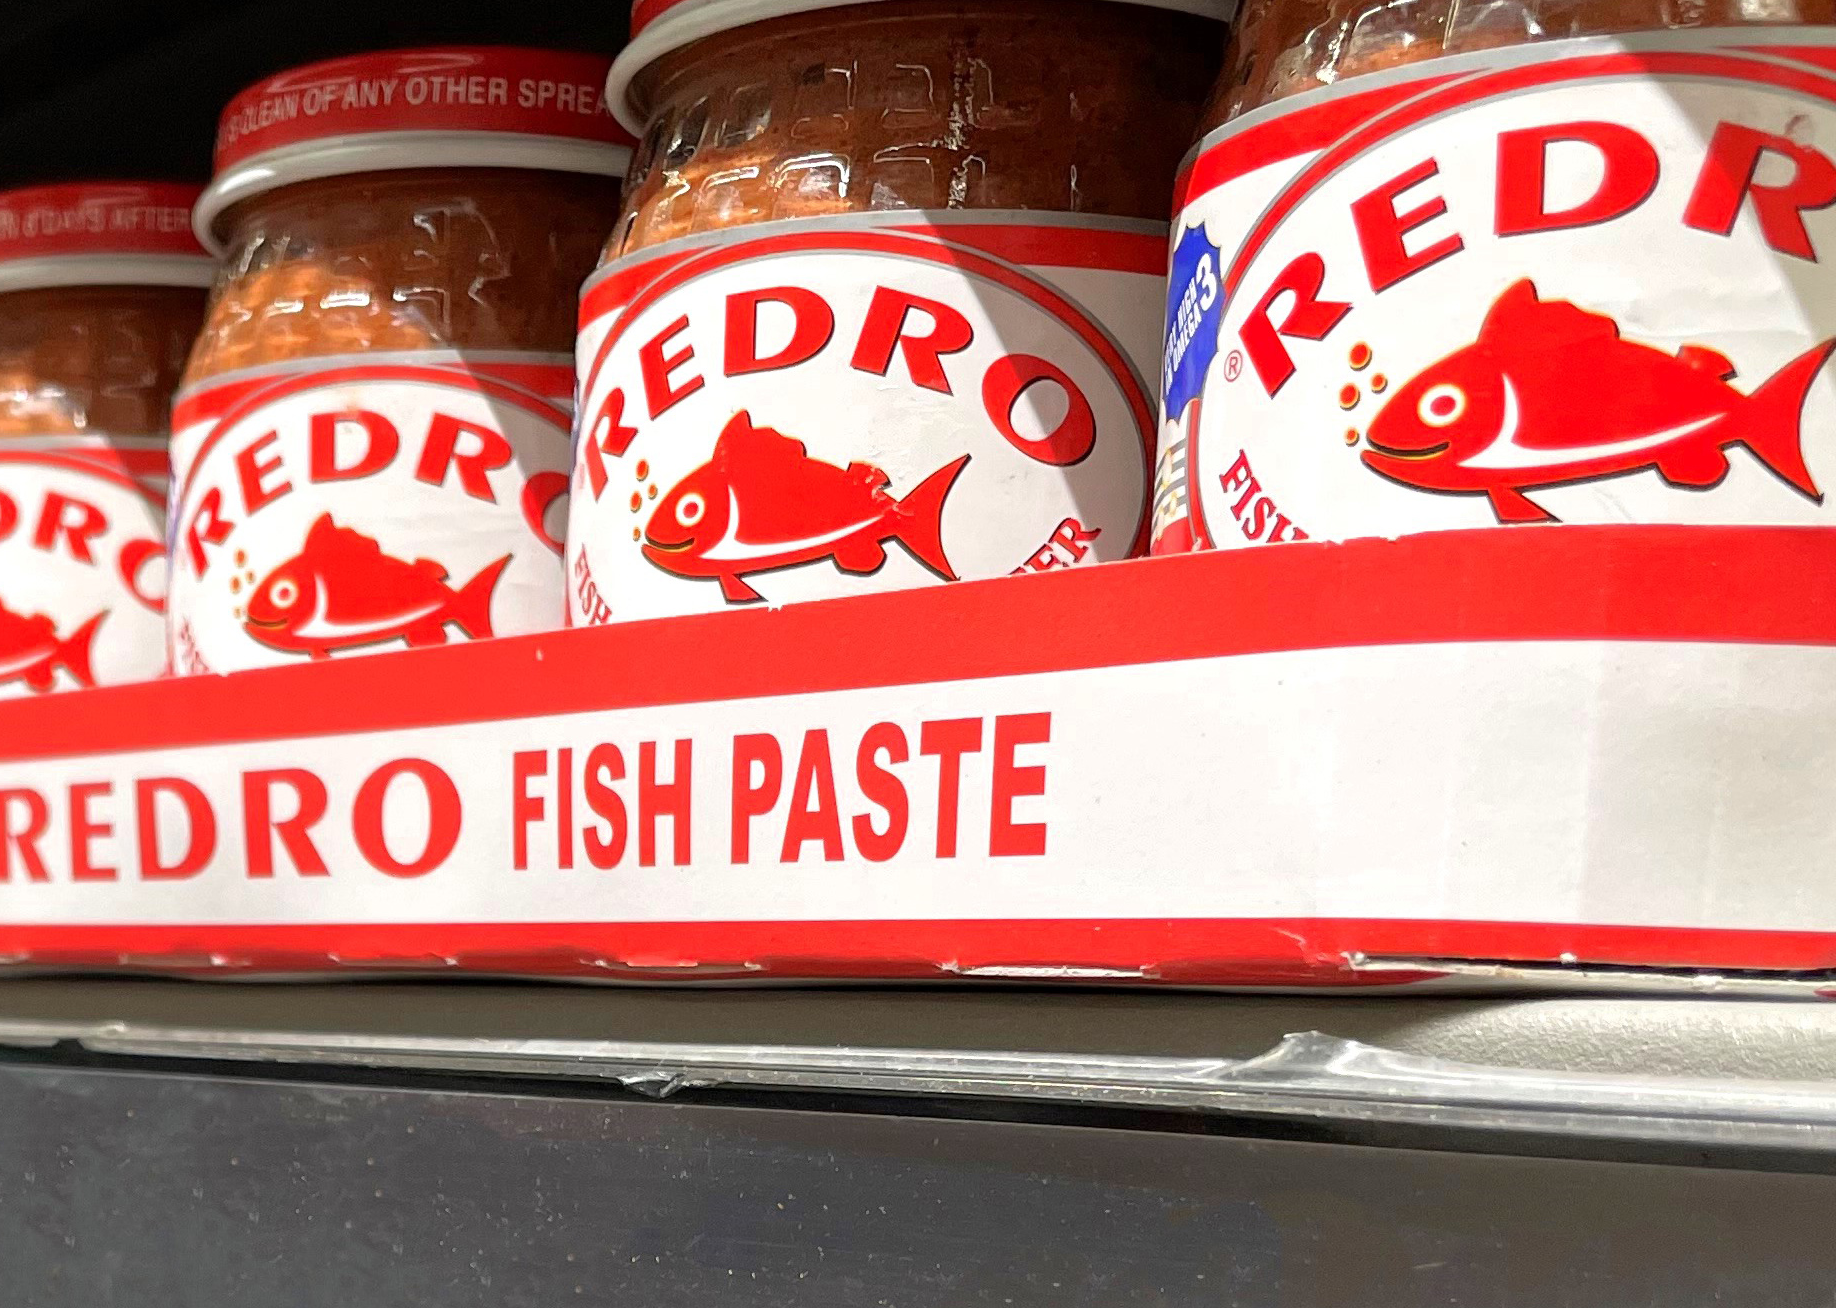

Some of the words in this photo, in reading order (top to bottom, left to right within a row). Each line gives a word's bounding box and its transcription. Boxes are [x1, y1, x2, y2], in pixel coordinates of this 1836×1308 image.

[303, 84, 340, 116] OF
[342, 79, 397, 110] ANY
[404, 75, 508, 106] OTHER
[1196, 253, 1218, 312] 3
[584, 285, 1097, 500] REDRO
[511, 737, 694, 871] FISH
[729, 711, 1053, 866] PASTE
